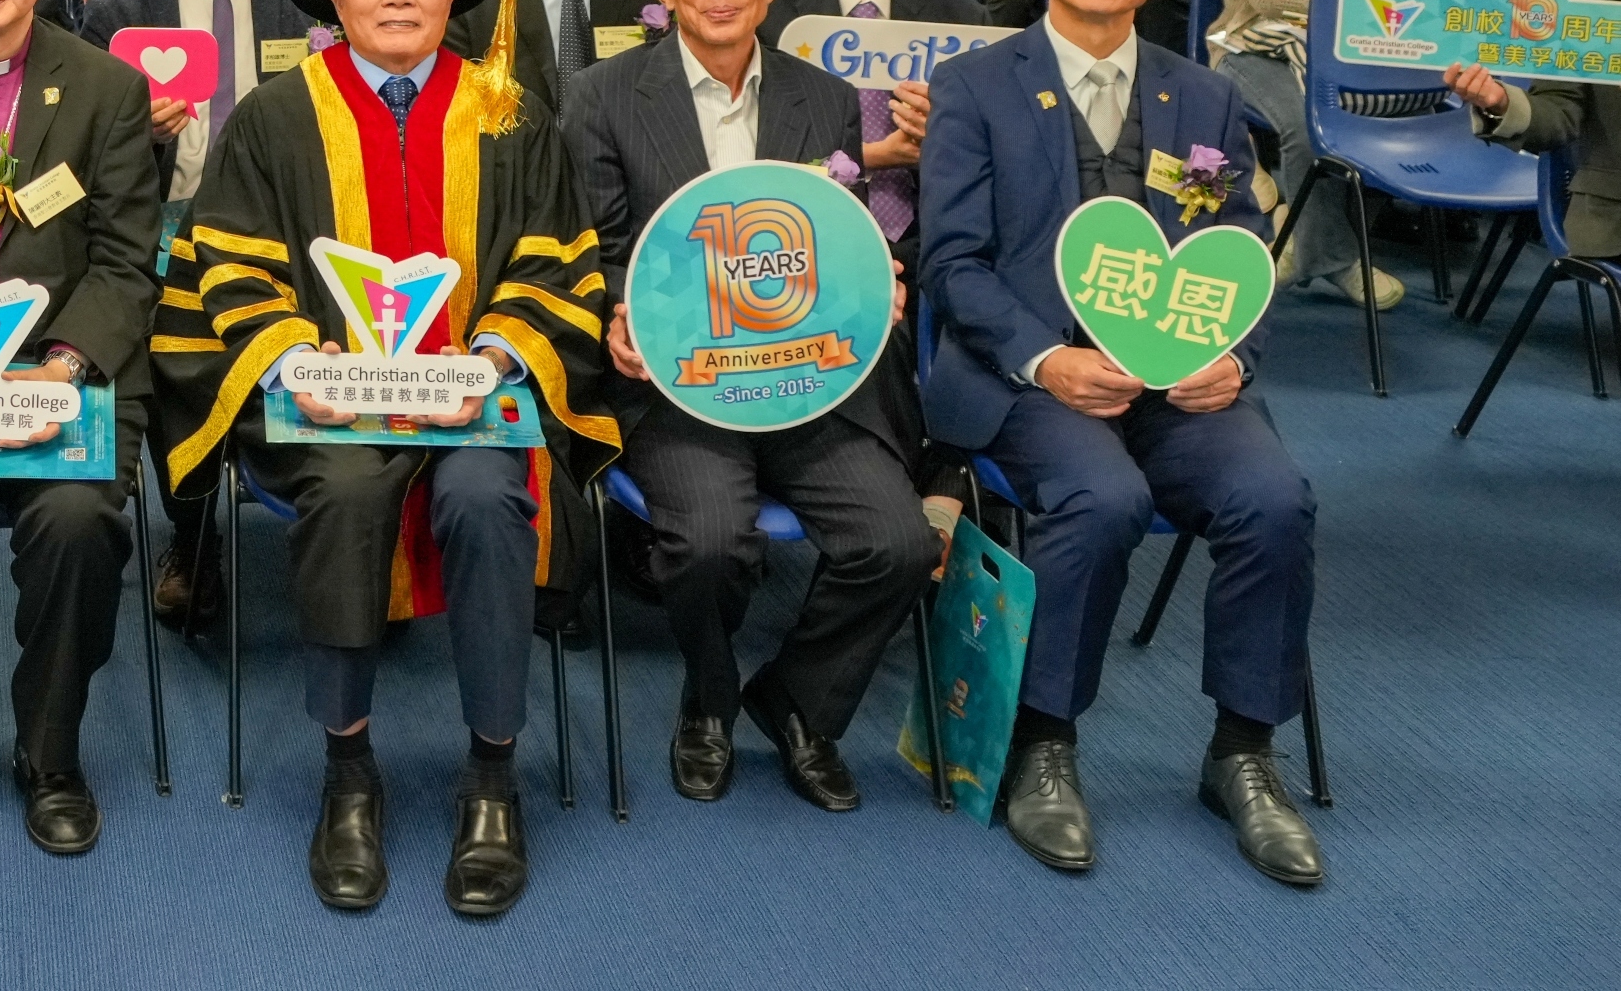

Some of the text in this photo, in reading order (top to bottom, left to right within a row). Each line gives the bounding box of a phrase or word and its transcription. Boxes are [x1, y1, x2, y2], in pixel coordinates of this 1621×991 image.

[1518, 10, 1554, 23] YEARS
[821, 29, 988, 83] Grat
[1349, 37, 1434, 52] Gratia Christian College
[686, 198, 819, 340] 10
[724, 251, 807, 280] YEARS
[1074, 243, 1239, 347] 感恩
[705, 340, 826, 368] Anniversary
[293, 366, 485, 387] Gratia Christian College
[9, 393, 69, 412] College
[324, 386, 450, 404] 宏恩基督教學院
